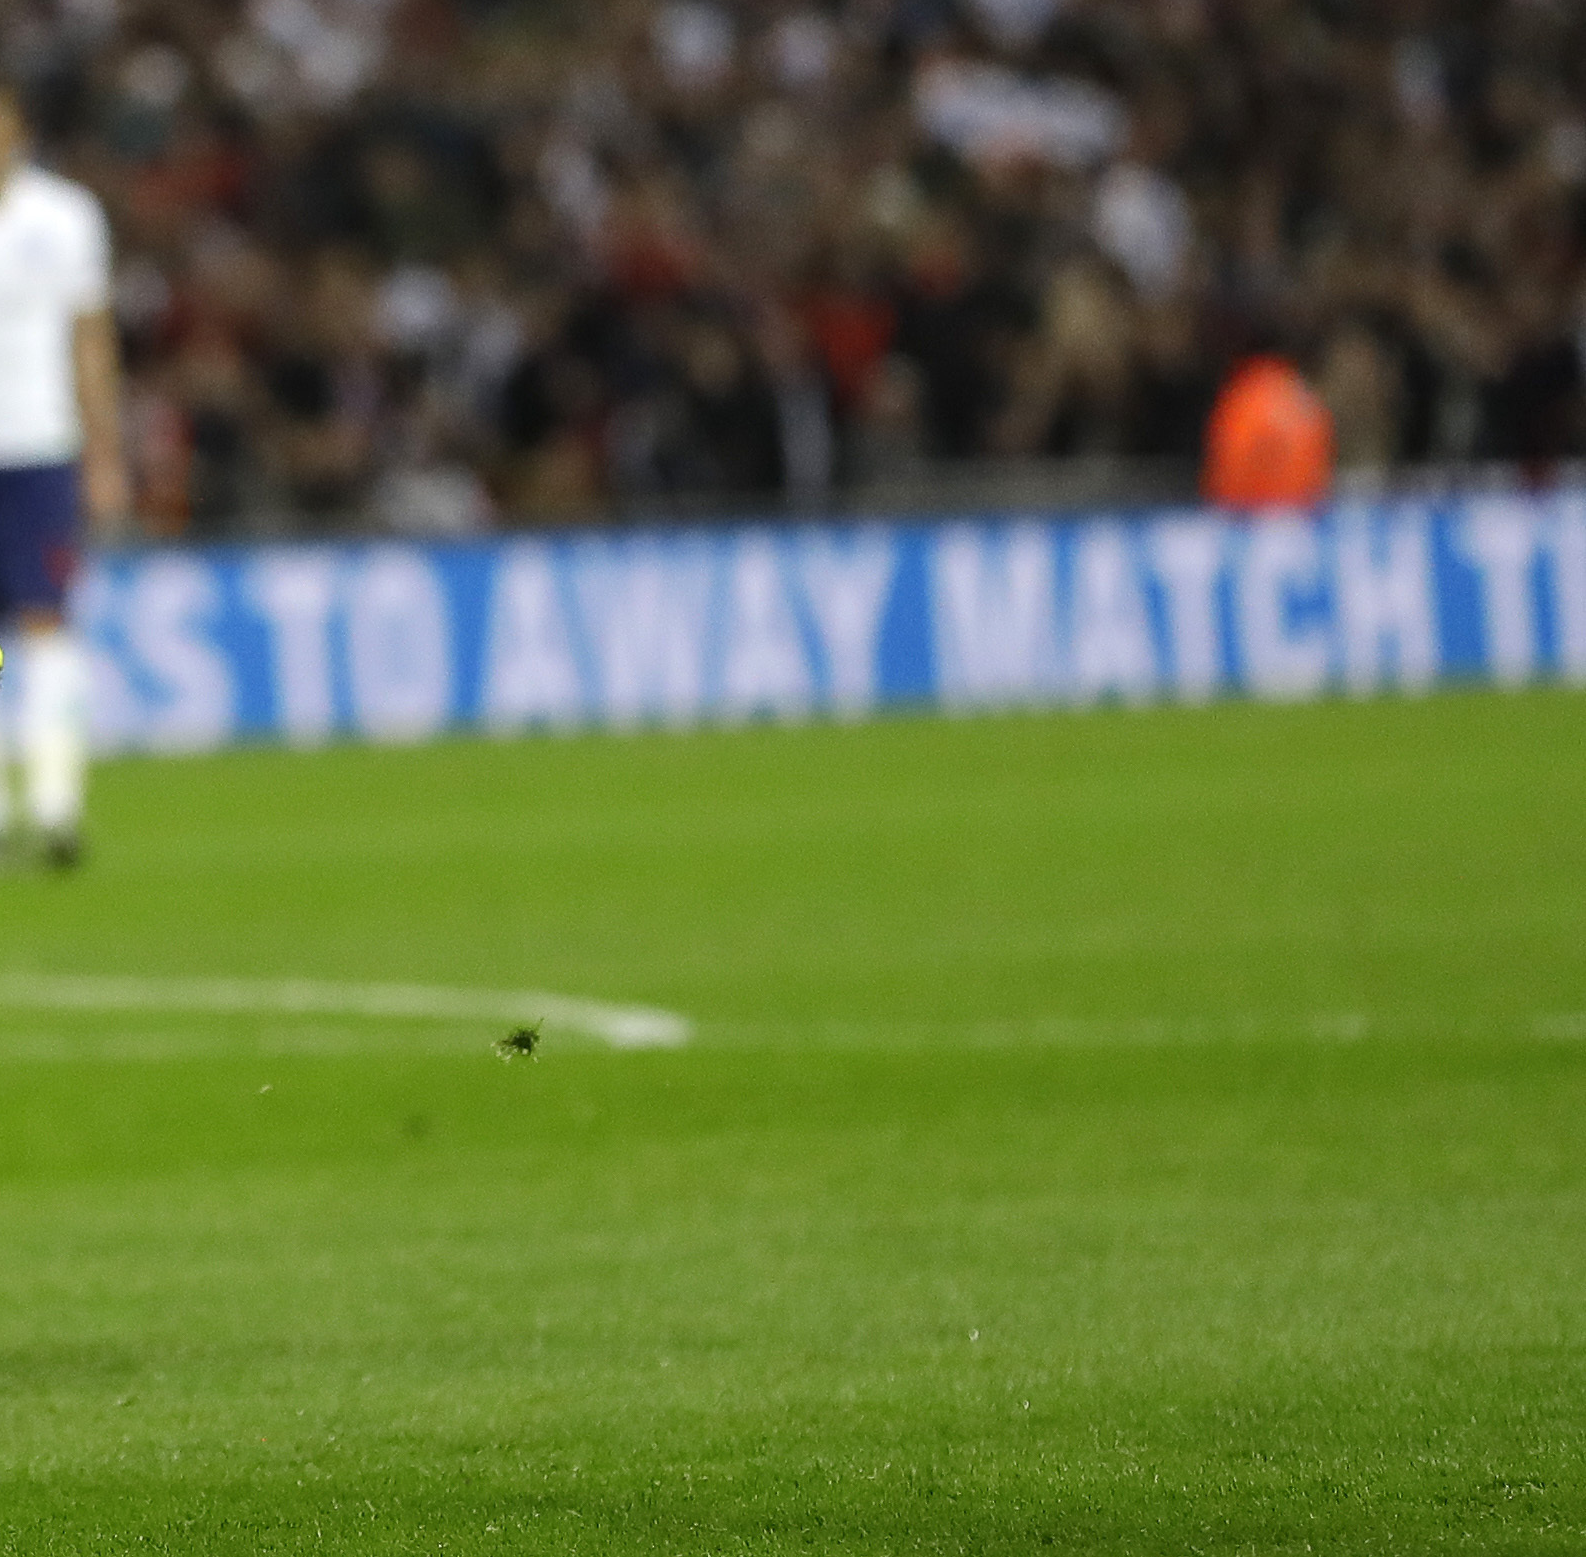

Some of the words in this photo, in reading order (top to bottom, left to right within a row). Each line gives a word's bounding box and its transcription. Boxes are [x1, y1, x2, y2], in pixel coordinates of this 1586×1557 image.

[250, 544, 440, 748] TO
[482, 518, 894, 736] AWAY
[932, 500, 1432, 714] MATCH
